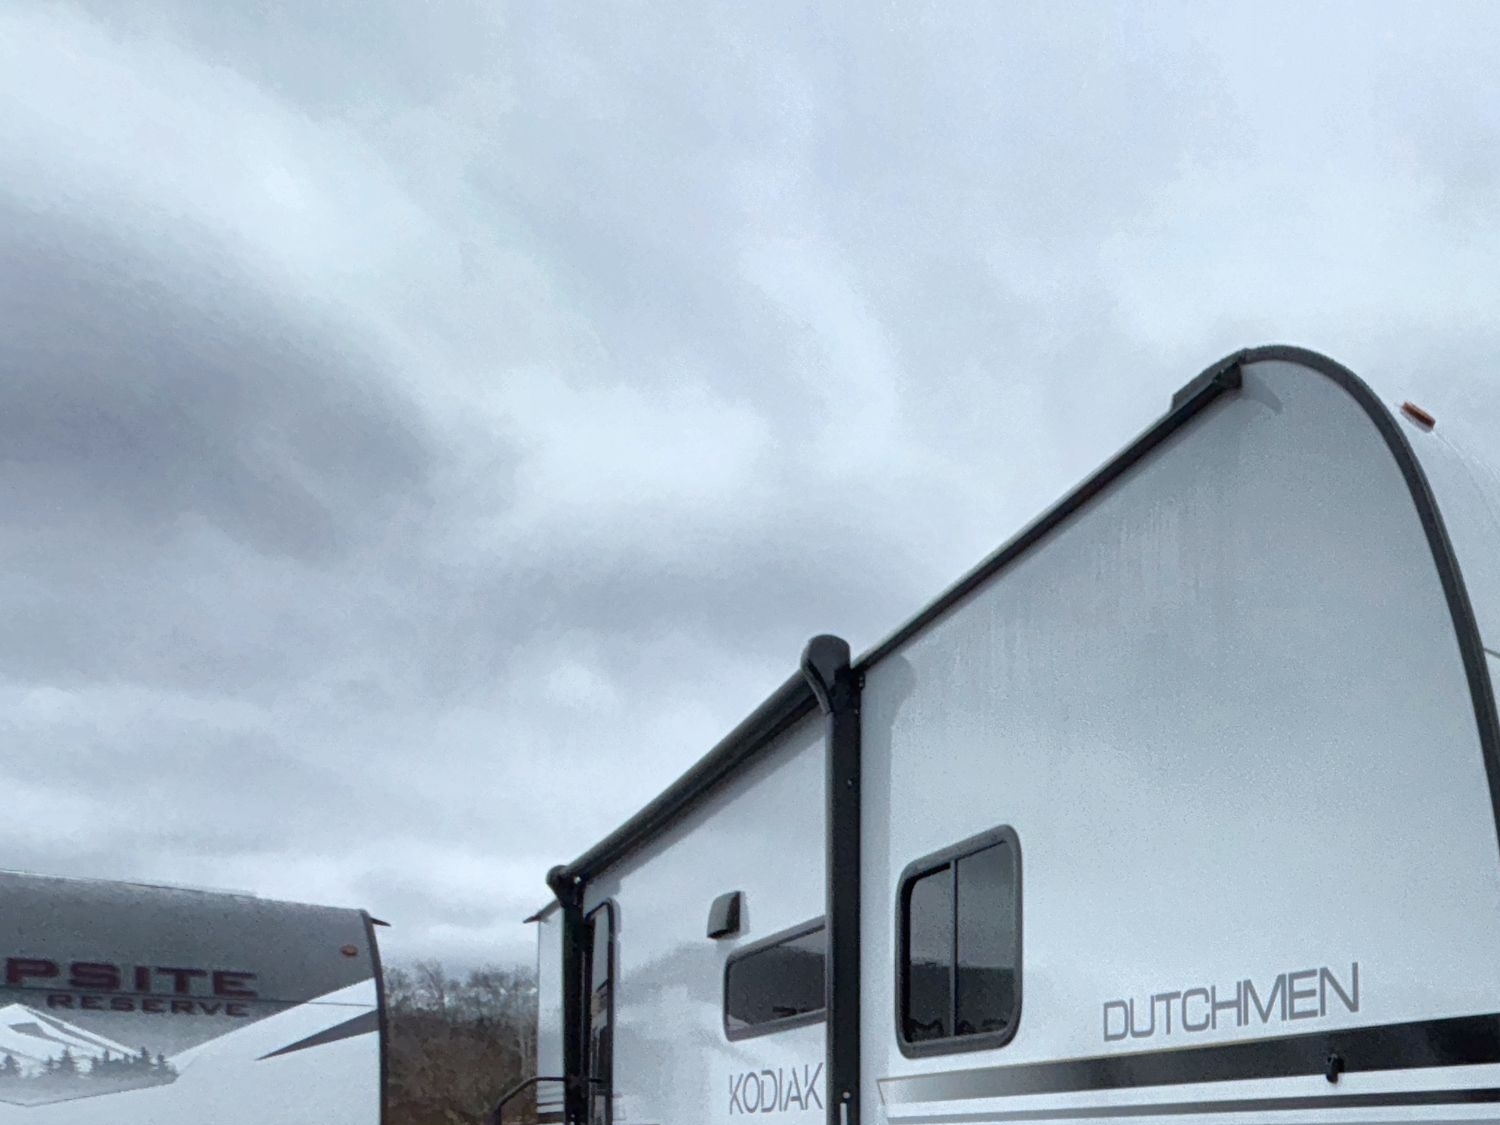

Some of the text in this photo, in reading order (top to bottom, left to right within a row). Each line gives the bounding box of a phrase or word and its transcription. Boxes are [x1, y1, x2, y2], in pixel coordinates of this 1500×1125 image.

[47, 994, 250, 1017] RESERVE
[1103, 962, 1359, 1042] DUTCHMEN
[729, 1062, 824, 1115] KODIAK
